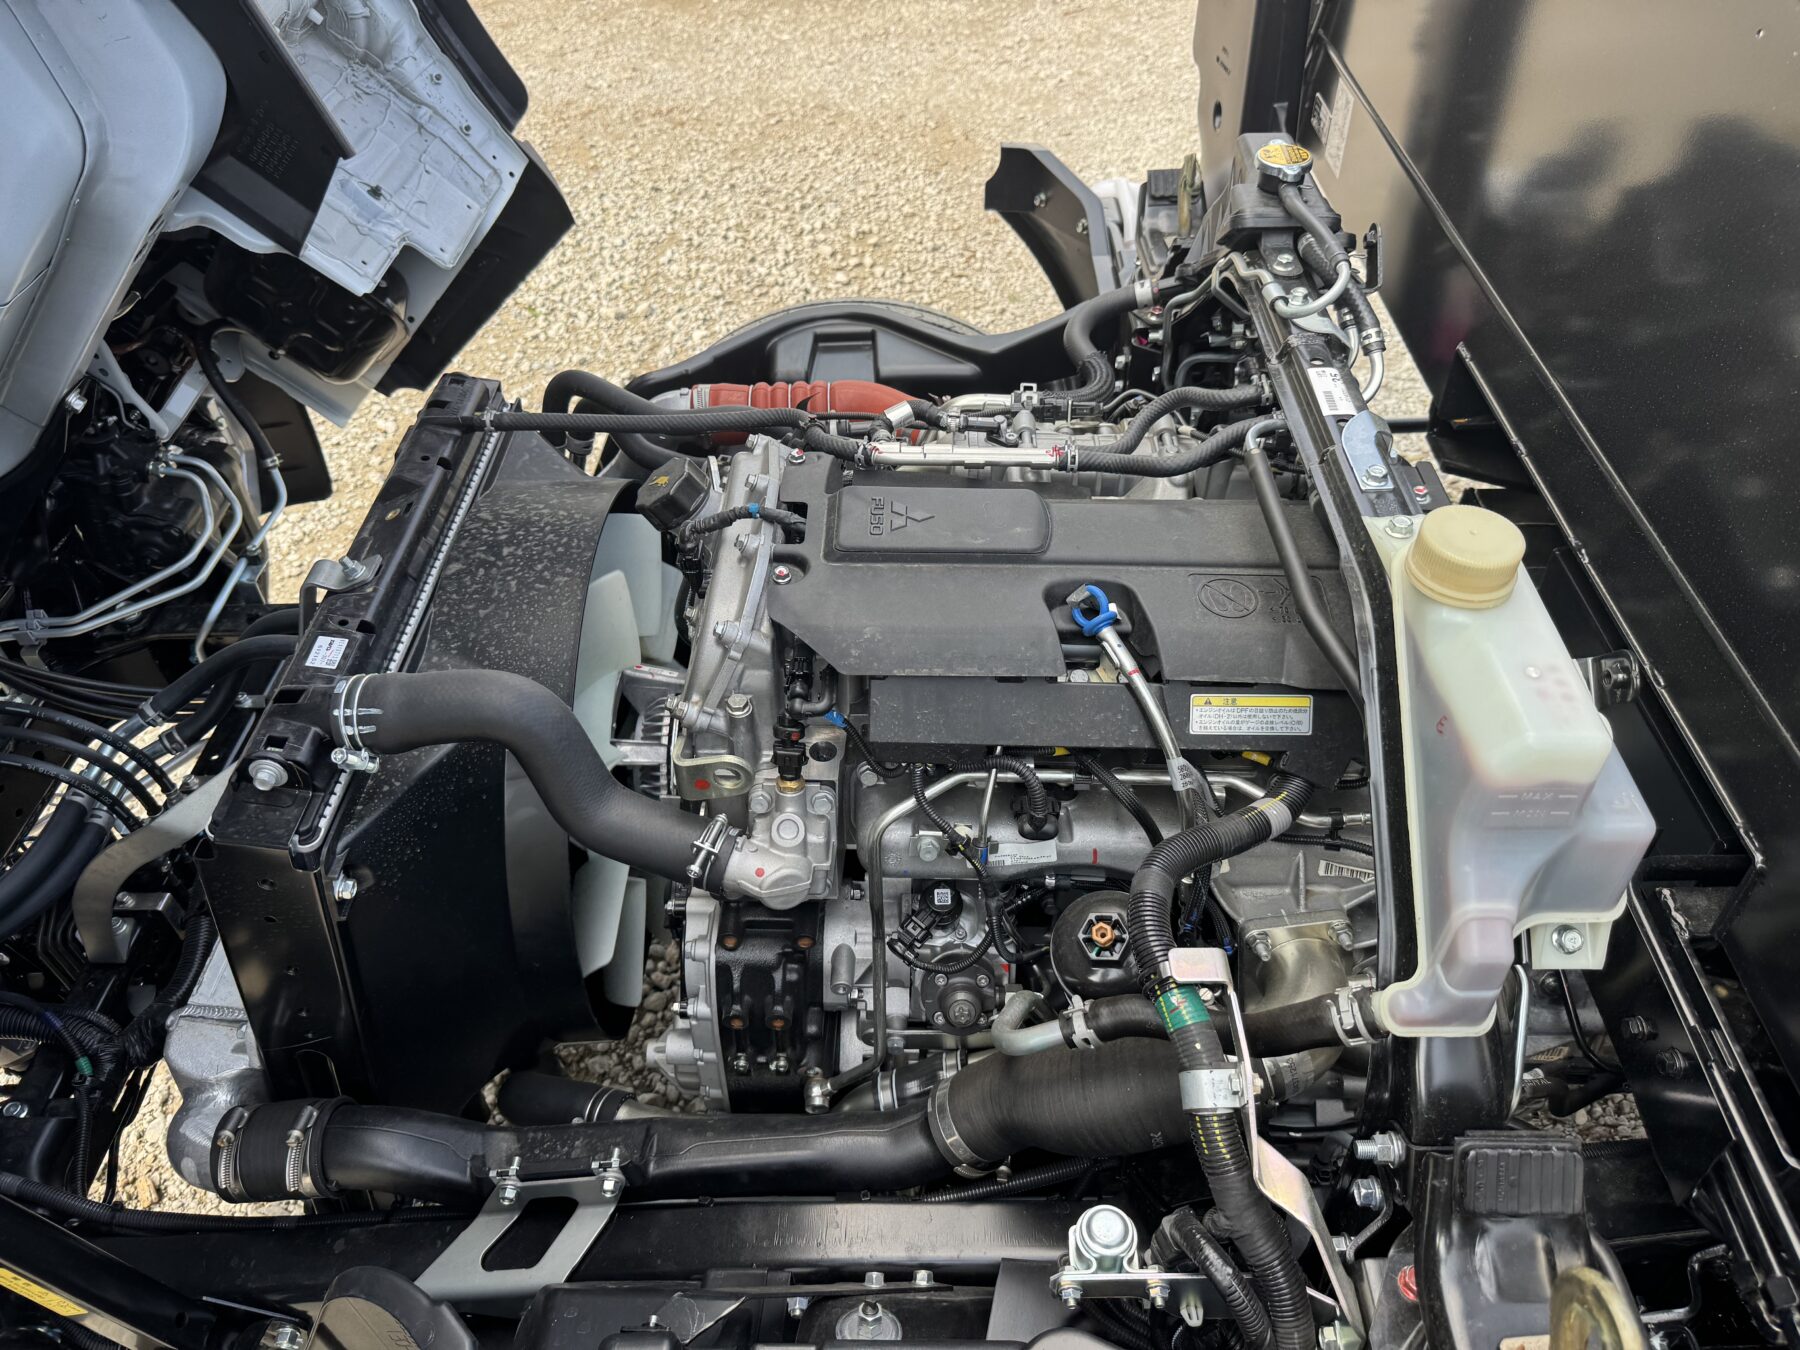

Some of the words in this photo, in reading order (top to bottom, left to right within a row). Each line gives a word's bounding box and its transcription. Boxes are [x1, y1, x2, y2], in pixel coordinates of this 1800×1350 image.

[870, 497, 884, 536] FUSO
[1222, 697, 1238, 706] 注意
[65, 719, 95, 733] JAPAN
